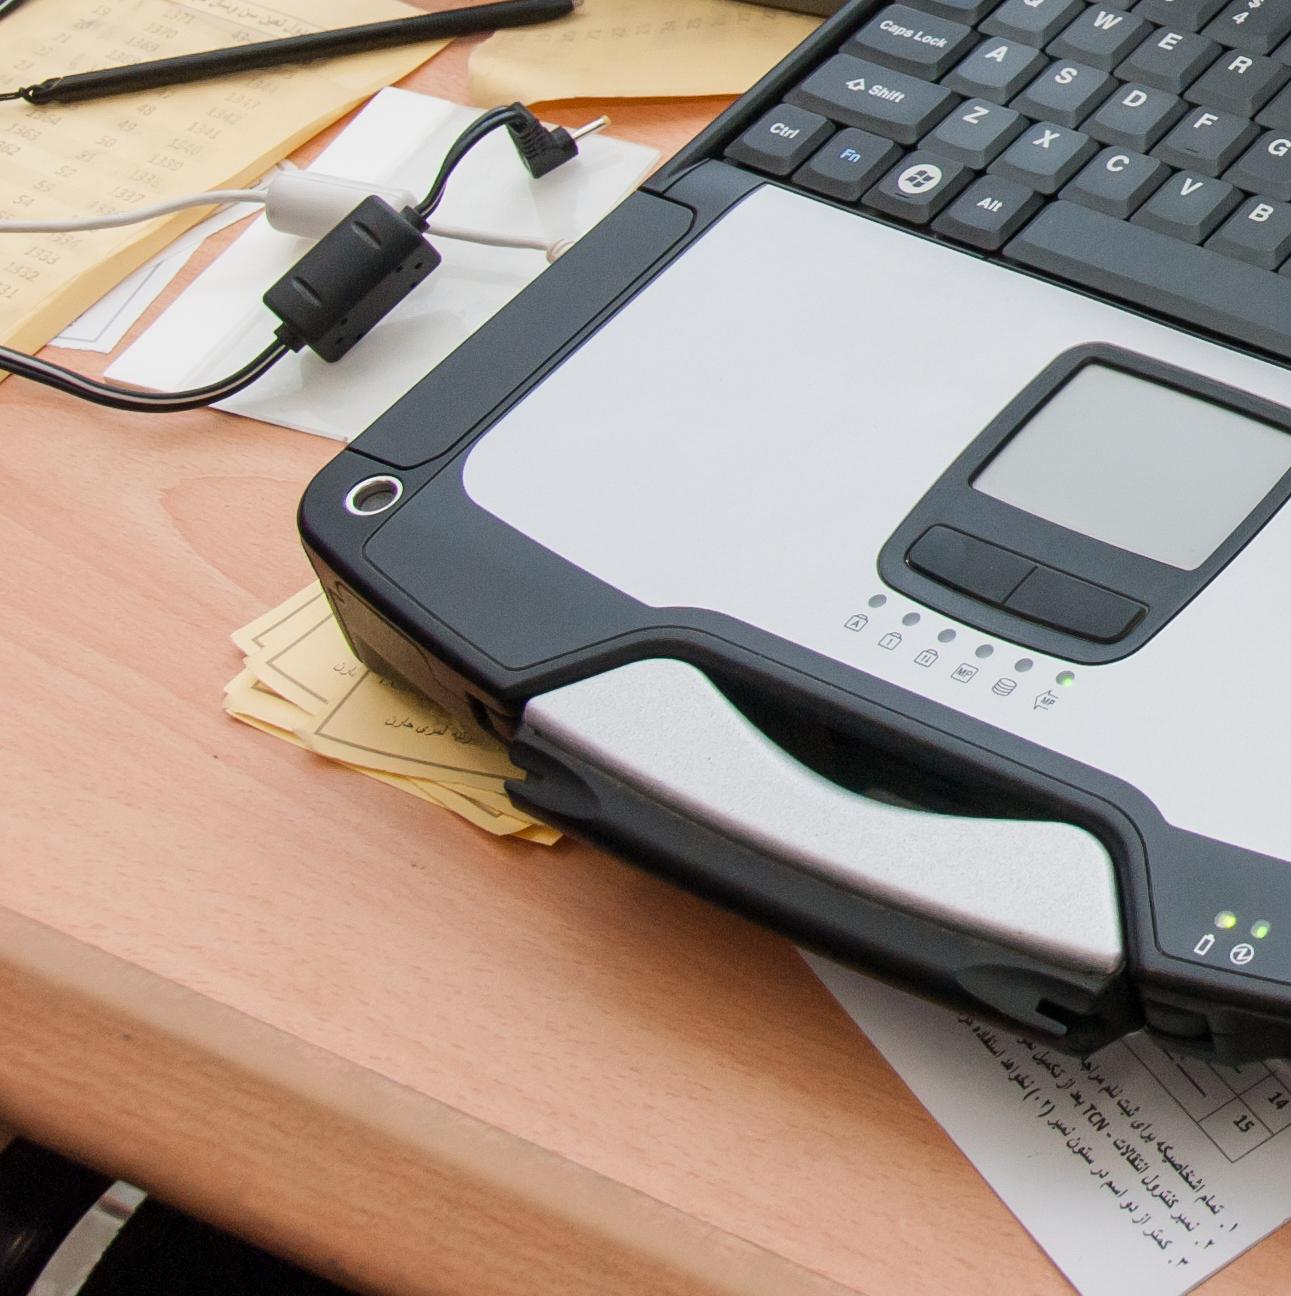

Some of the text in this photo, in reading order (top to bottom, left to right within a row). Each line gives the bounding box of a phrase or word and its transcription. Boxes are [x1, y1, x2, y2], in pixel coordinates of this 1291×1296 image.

[1094, 11, 1122, 29] W
[1233, 12, 1249, 24] 4
[880, 21, 946, 47] Caps Lock
[1158, 33, 1182, 50] E
[985, 46, 1007, 62] A
[1228, 56, 1252, 73] R
[1055, 68, 1077, 83] S
[869, 85, 904, 102] Shift
[1123, 90, 1147, 106] D
[963, 106, 989, 123] Z
[1194, 113, 1218, 128] F
[770, 123, 799, 138] Ctrl
[1033, 130, 1059, 148] X
[840, 149, 860, 162] Fn
[1268, 139, 1291, 156] G
[1107, 155, 1129, 171] C
[1181, 178, 1203, 195] V
[977, 198, 1002, 211] Alt
[1249, 204, 1273, 221] B
[1268, 1092, 1289, 1109] 14
[1084, 1104, 1110, 1132] TCN
[1233, 1113, 1256, 1132] 15
